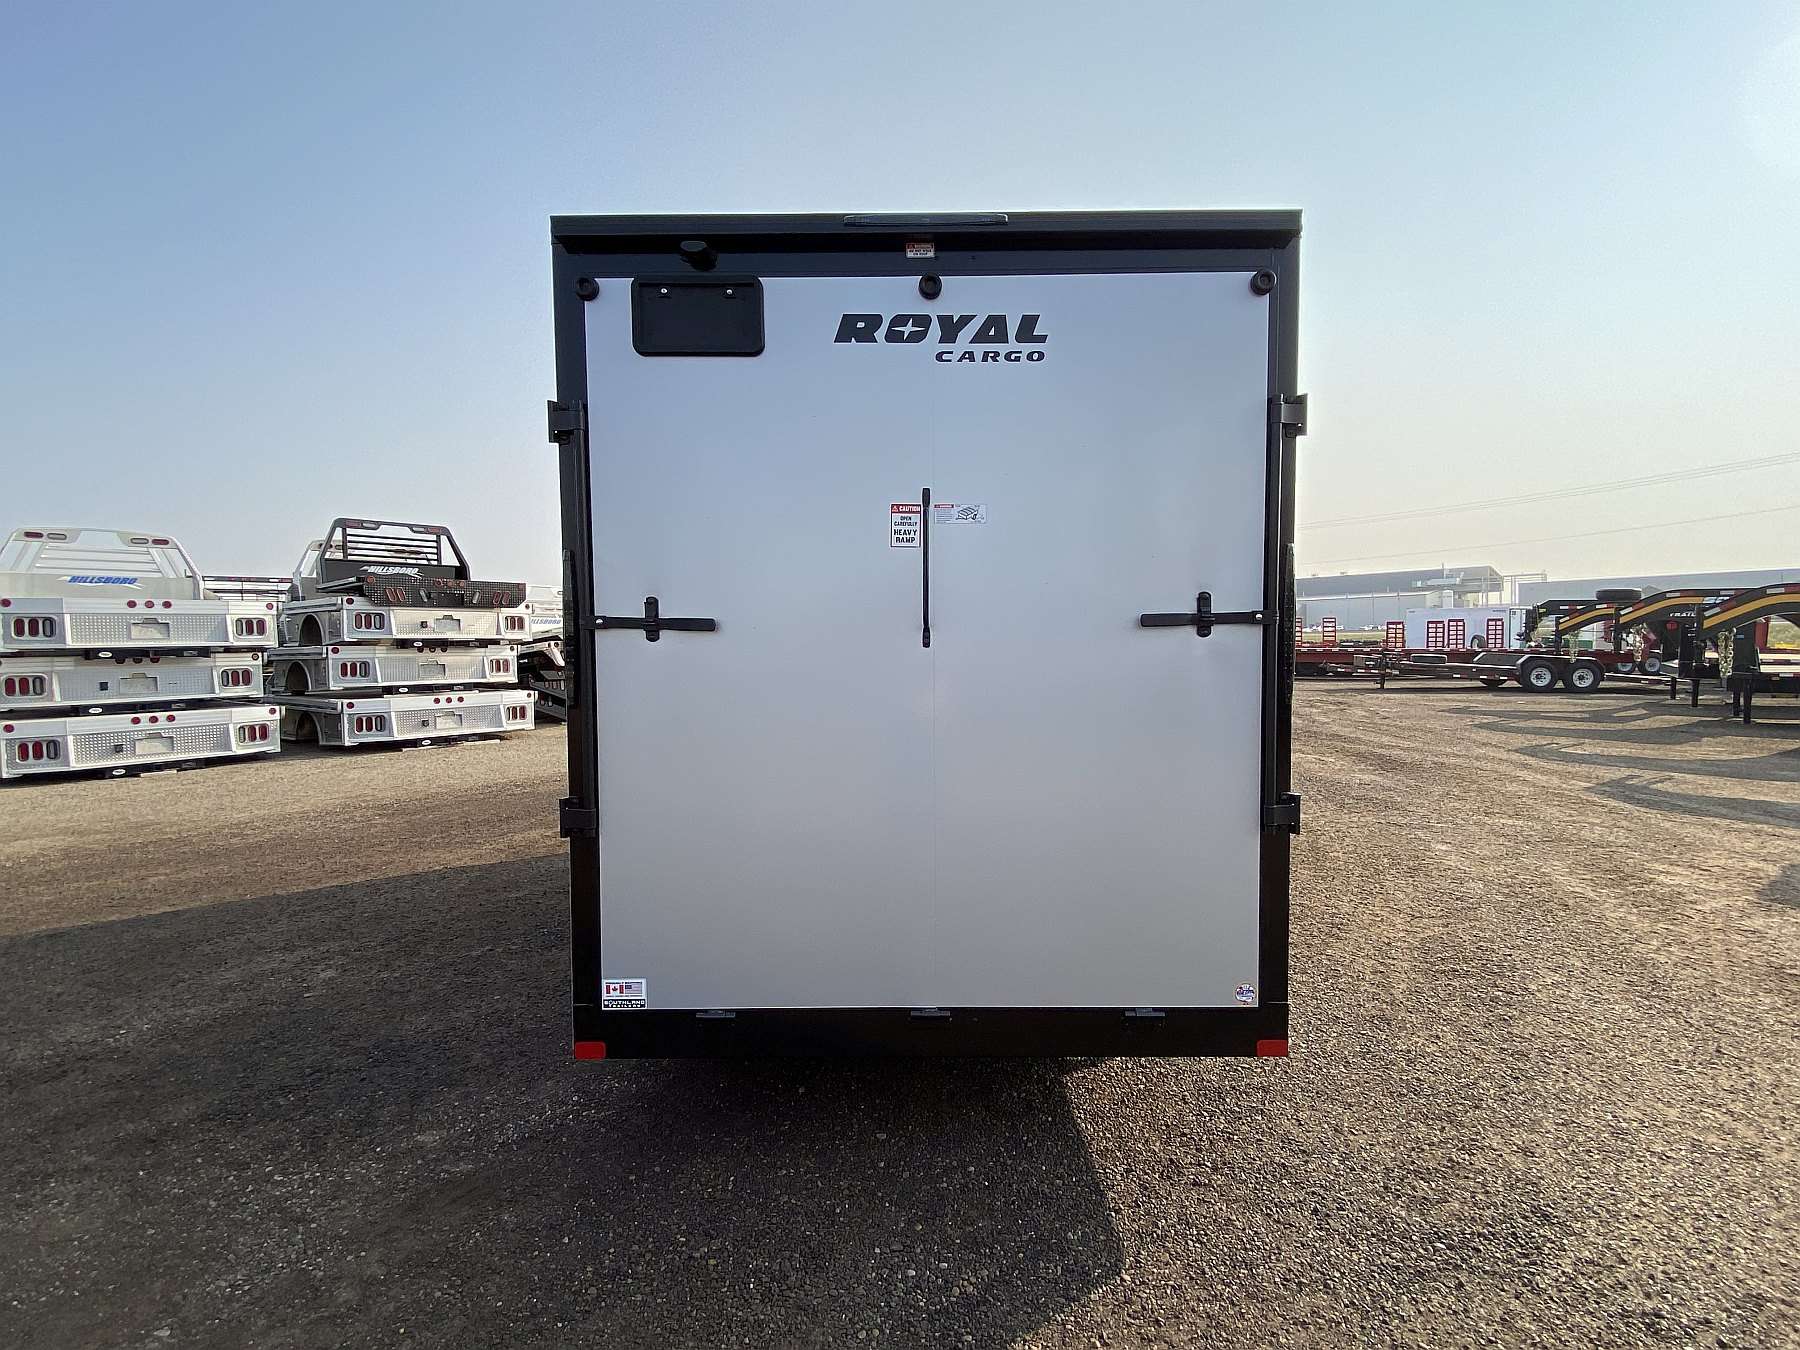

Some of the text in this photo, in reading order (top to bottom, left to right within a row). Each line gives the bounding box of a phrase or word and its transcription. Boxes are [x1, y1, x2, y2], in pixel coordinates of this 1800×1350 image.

[834, 313, 1048, 343] ROYAL
[935, 350, 1045, 362] CARGO
[368, 565, 419, 575] HILLSBORO
[68, 575, 138, 585] HILLSBORO
